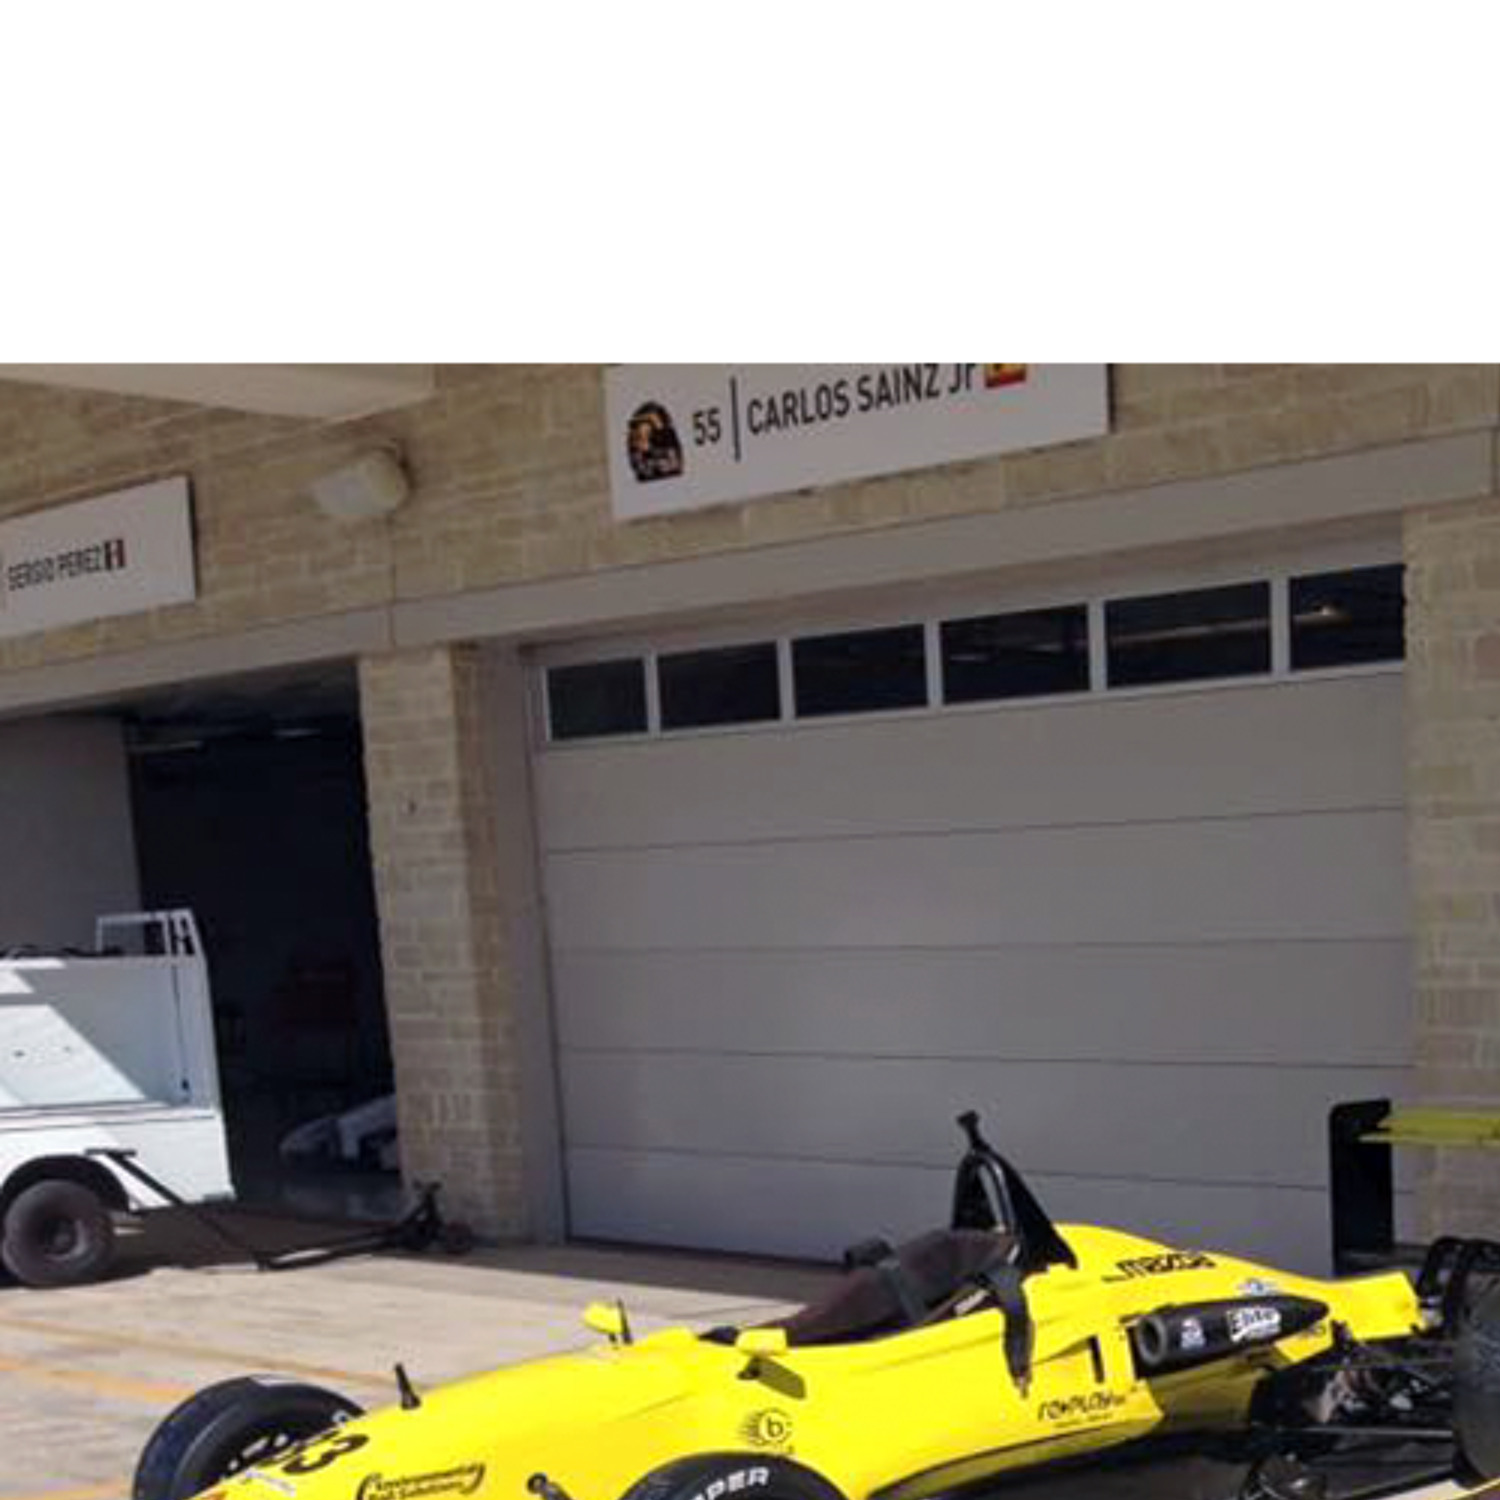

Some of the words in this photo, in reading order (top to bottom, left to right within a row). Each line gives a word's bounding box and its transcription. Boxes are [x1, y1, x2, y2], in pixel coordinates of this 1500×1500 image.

[692, 407, 721, 446] 55
[746, 378, 850, 436] CARLOS
[856, 363, 940, 413] SAINZ
[7, 556, 55, 592] SERGIO
[56, 544, 101, 578] PEREZ
